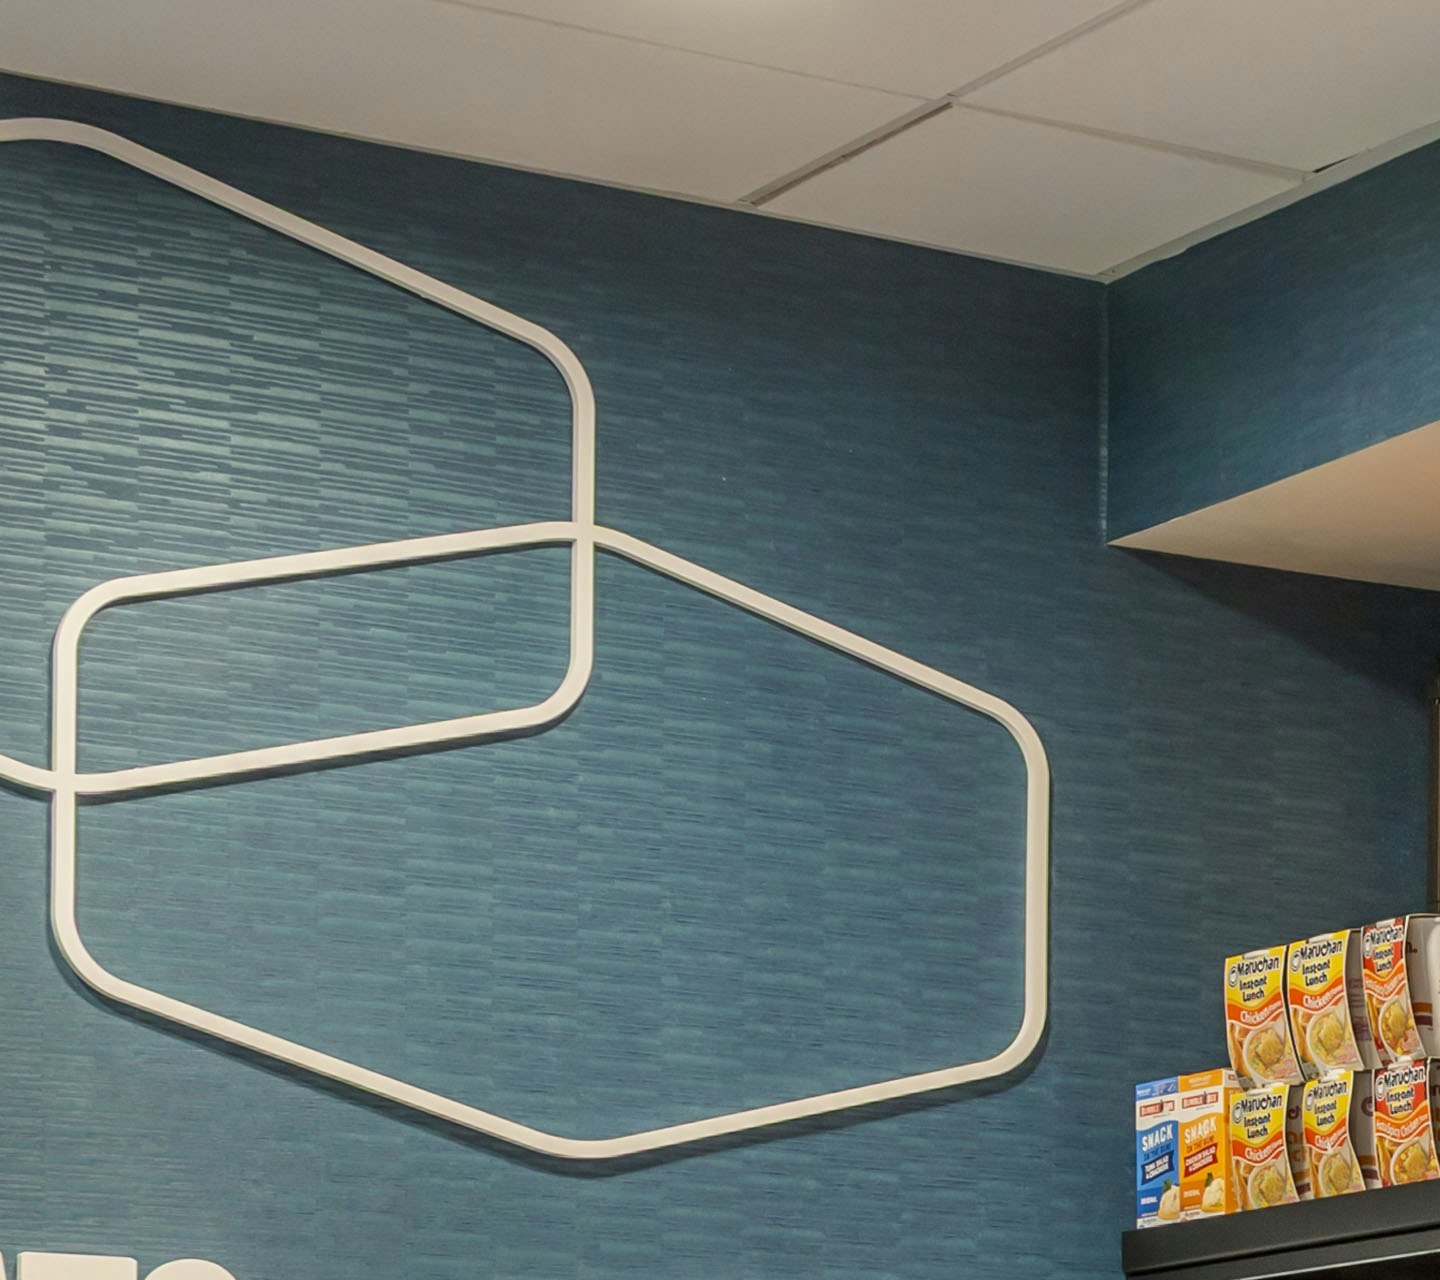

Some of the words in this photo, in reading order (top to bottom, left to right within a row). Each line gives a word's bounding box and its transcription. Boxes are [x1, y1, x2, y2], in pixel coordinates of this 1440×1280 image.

[1299, 939, 1342, 960] Maruchan
[1236, 955, 1280, 978] Maruchan
[1301, 959, 1331, 976] Instant
[1238, 975, 1268, 992] Instant
